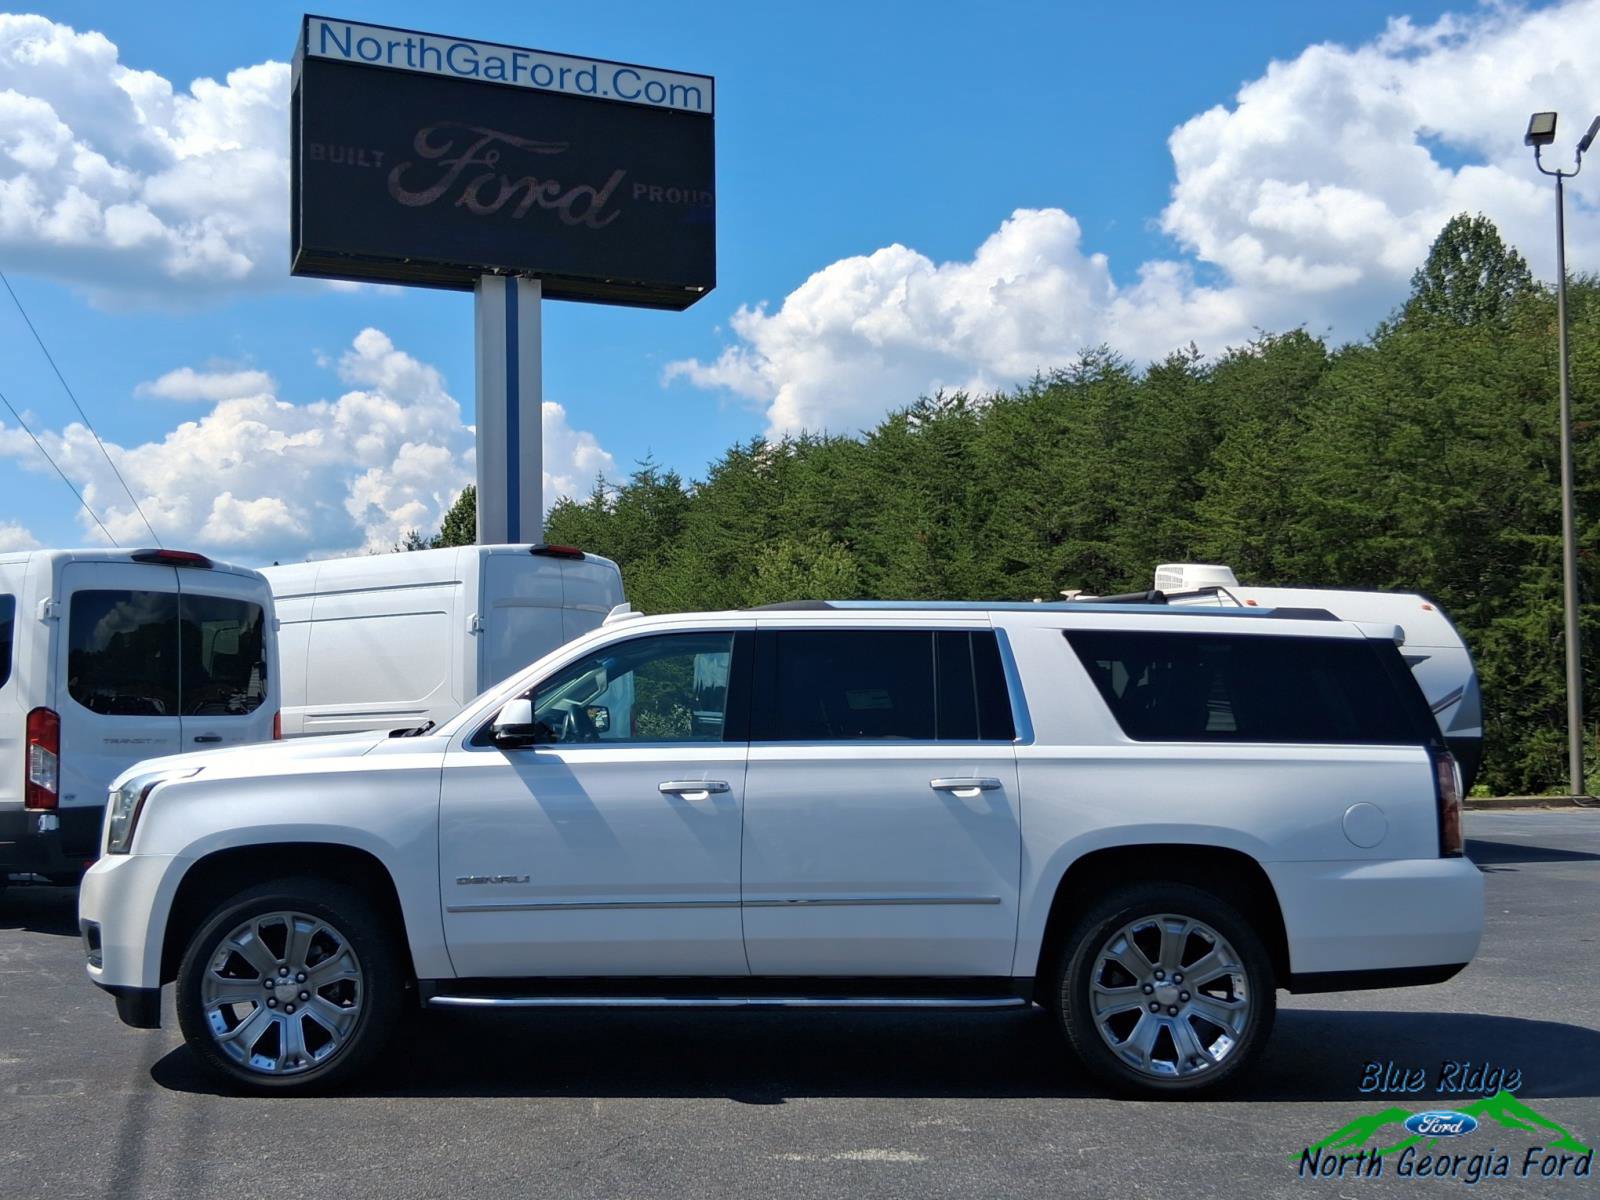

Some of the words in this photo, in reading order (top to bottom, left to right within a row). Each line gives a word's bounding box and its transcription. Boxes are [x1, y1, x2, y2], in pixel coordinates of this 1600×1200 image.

[320, 23, 702, 109] NorthGaFord.Com
[309, 142, 384, 168] BUILT
[387, 120, 628, 230] Ford
[632, 181, 714, 208] PROUD
[456, 874, 530, 885] DENALI
